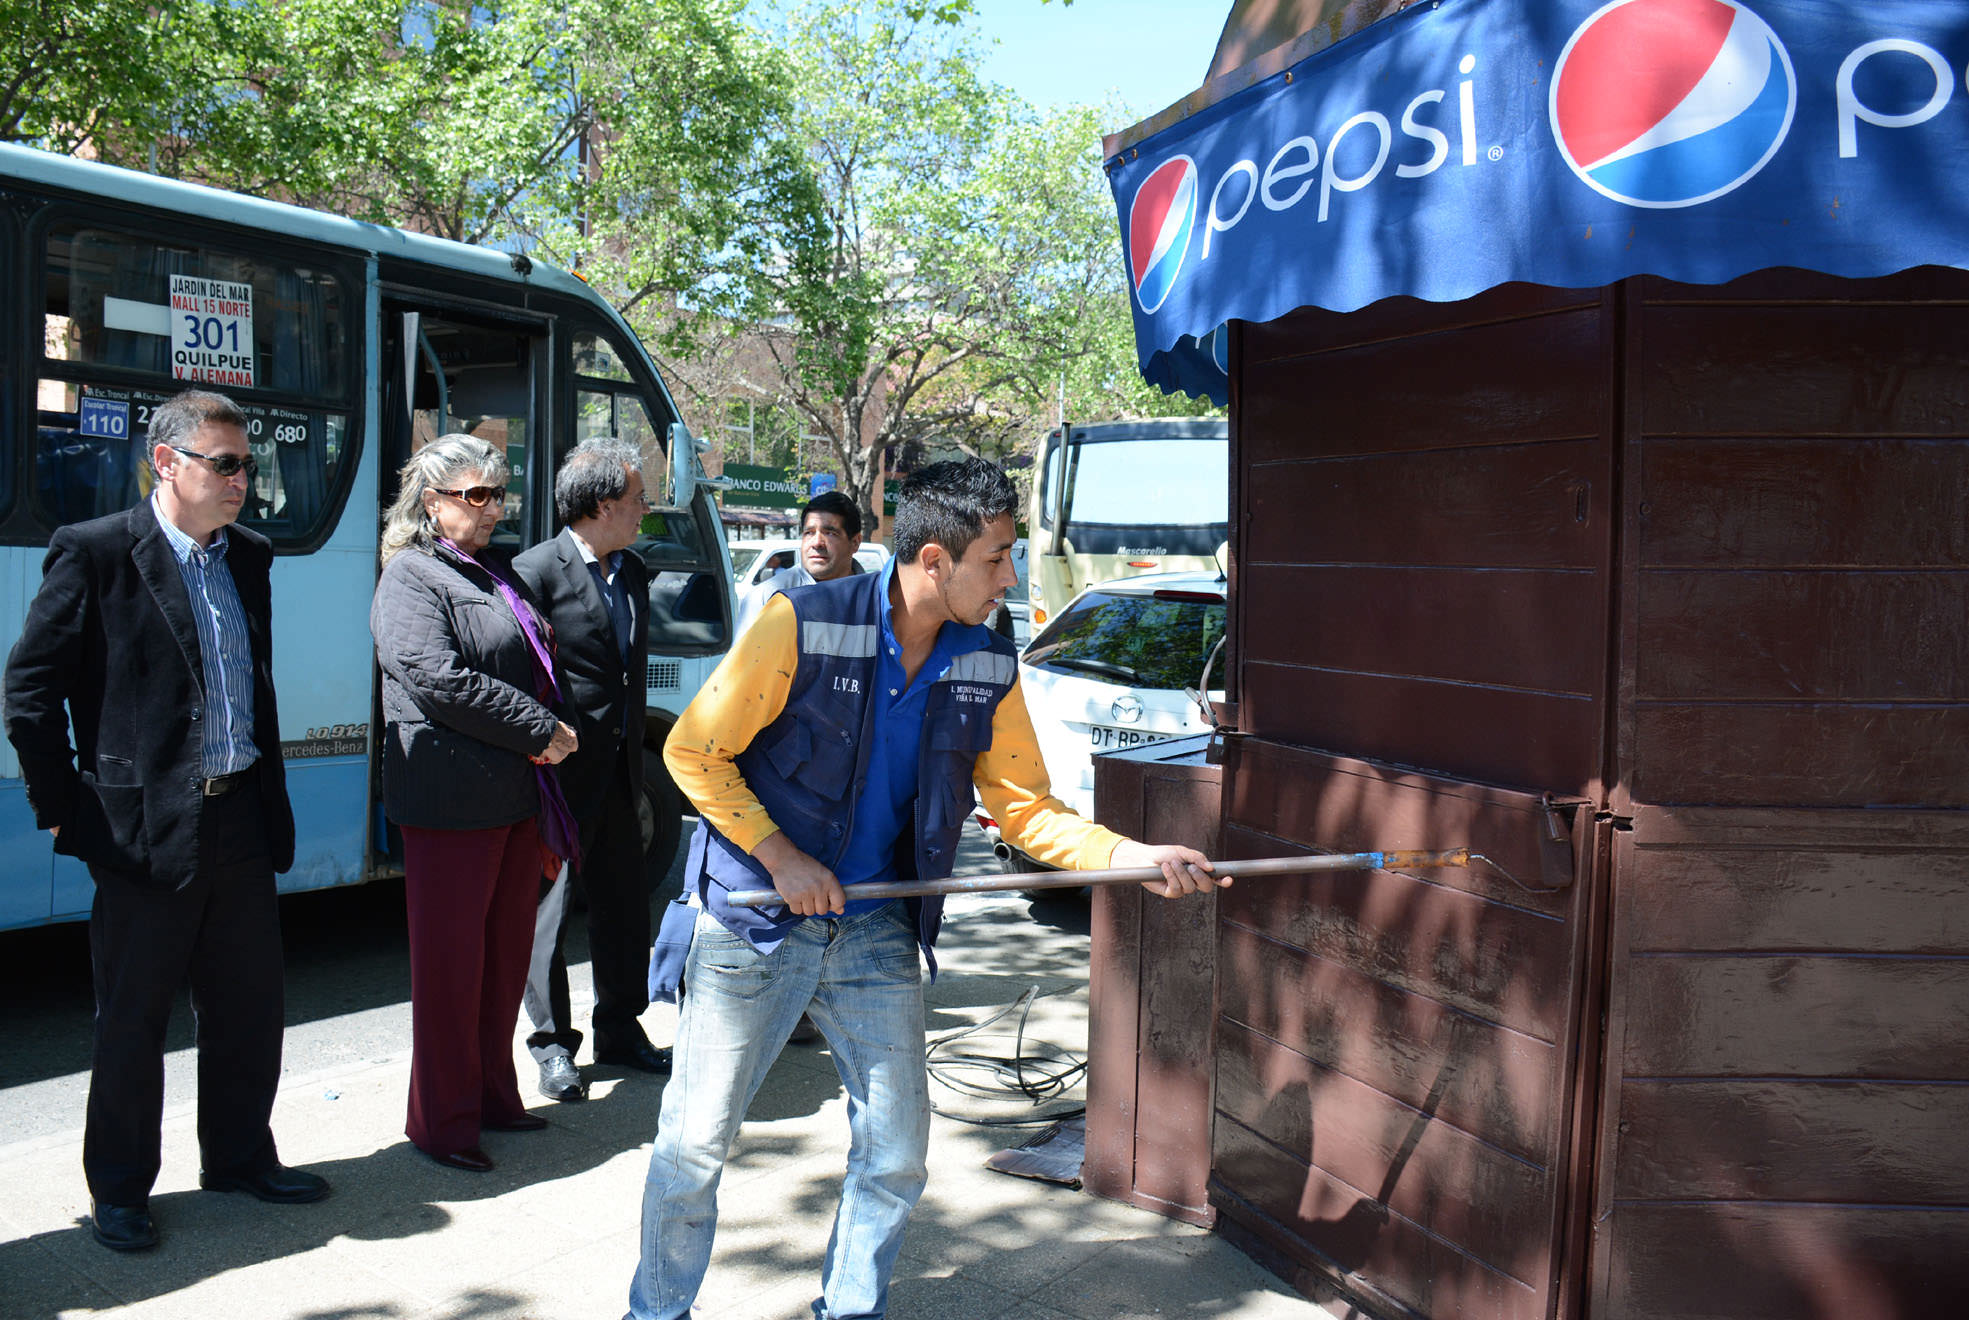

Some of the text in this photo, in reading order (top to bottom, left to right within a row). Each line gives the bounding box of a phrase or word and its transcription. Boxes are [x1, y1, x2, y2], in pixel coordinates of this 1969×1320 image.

[1836, 38, 1969, 159] p
[1201, 54, 1477, 261] pepsi
[173, 279, 249, 302] JARDIN DEL MAR
[172, 295, 251, 318] MALL 15 NORTE
[184, 314, 239, 353] 301
[175, 350, 252, 371] QUILPUE
[191, 367, 253, 387] ALEMANA
[88, 413, 125, 435] 110
[280, 409, 308, 421] Directo
[275, 424, 307, 443] 680
[1116, 546, 1168, 556] Mascarello
[833, 676, 860, 694] I.V.B.
[306, 723, 368, 740] LO 914
[1092, 727, 1113, 747] DT
[281, 741, 364, 758] ercedes-Benz
